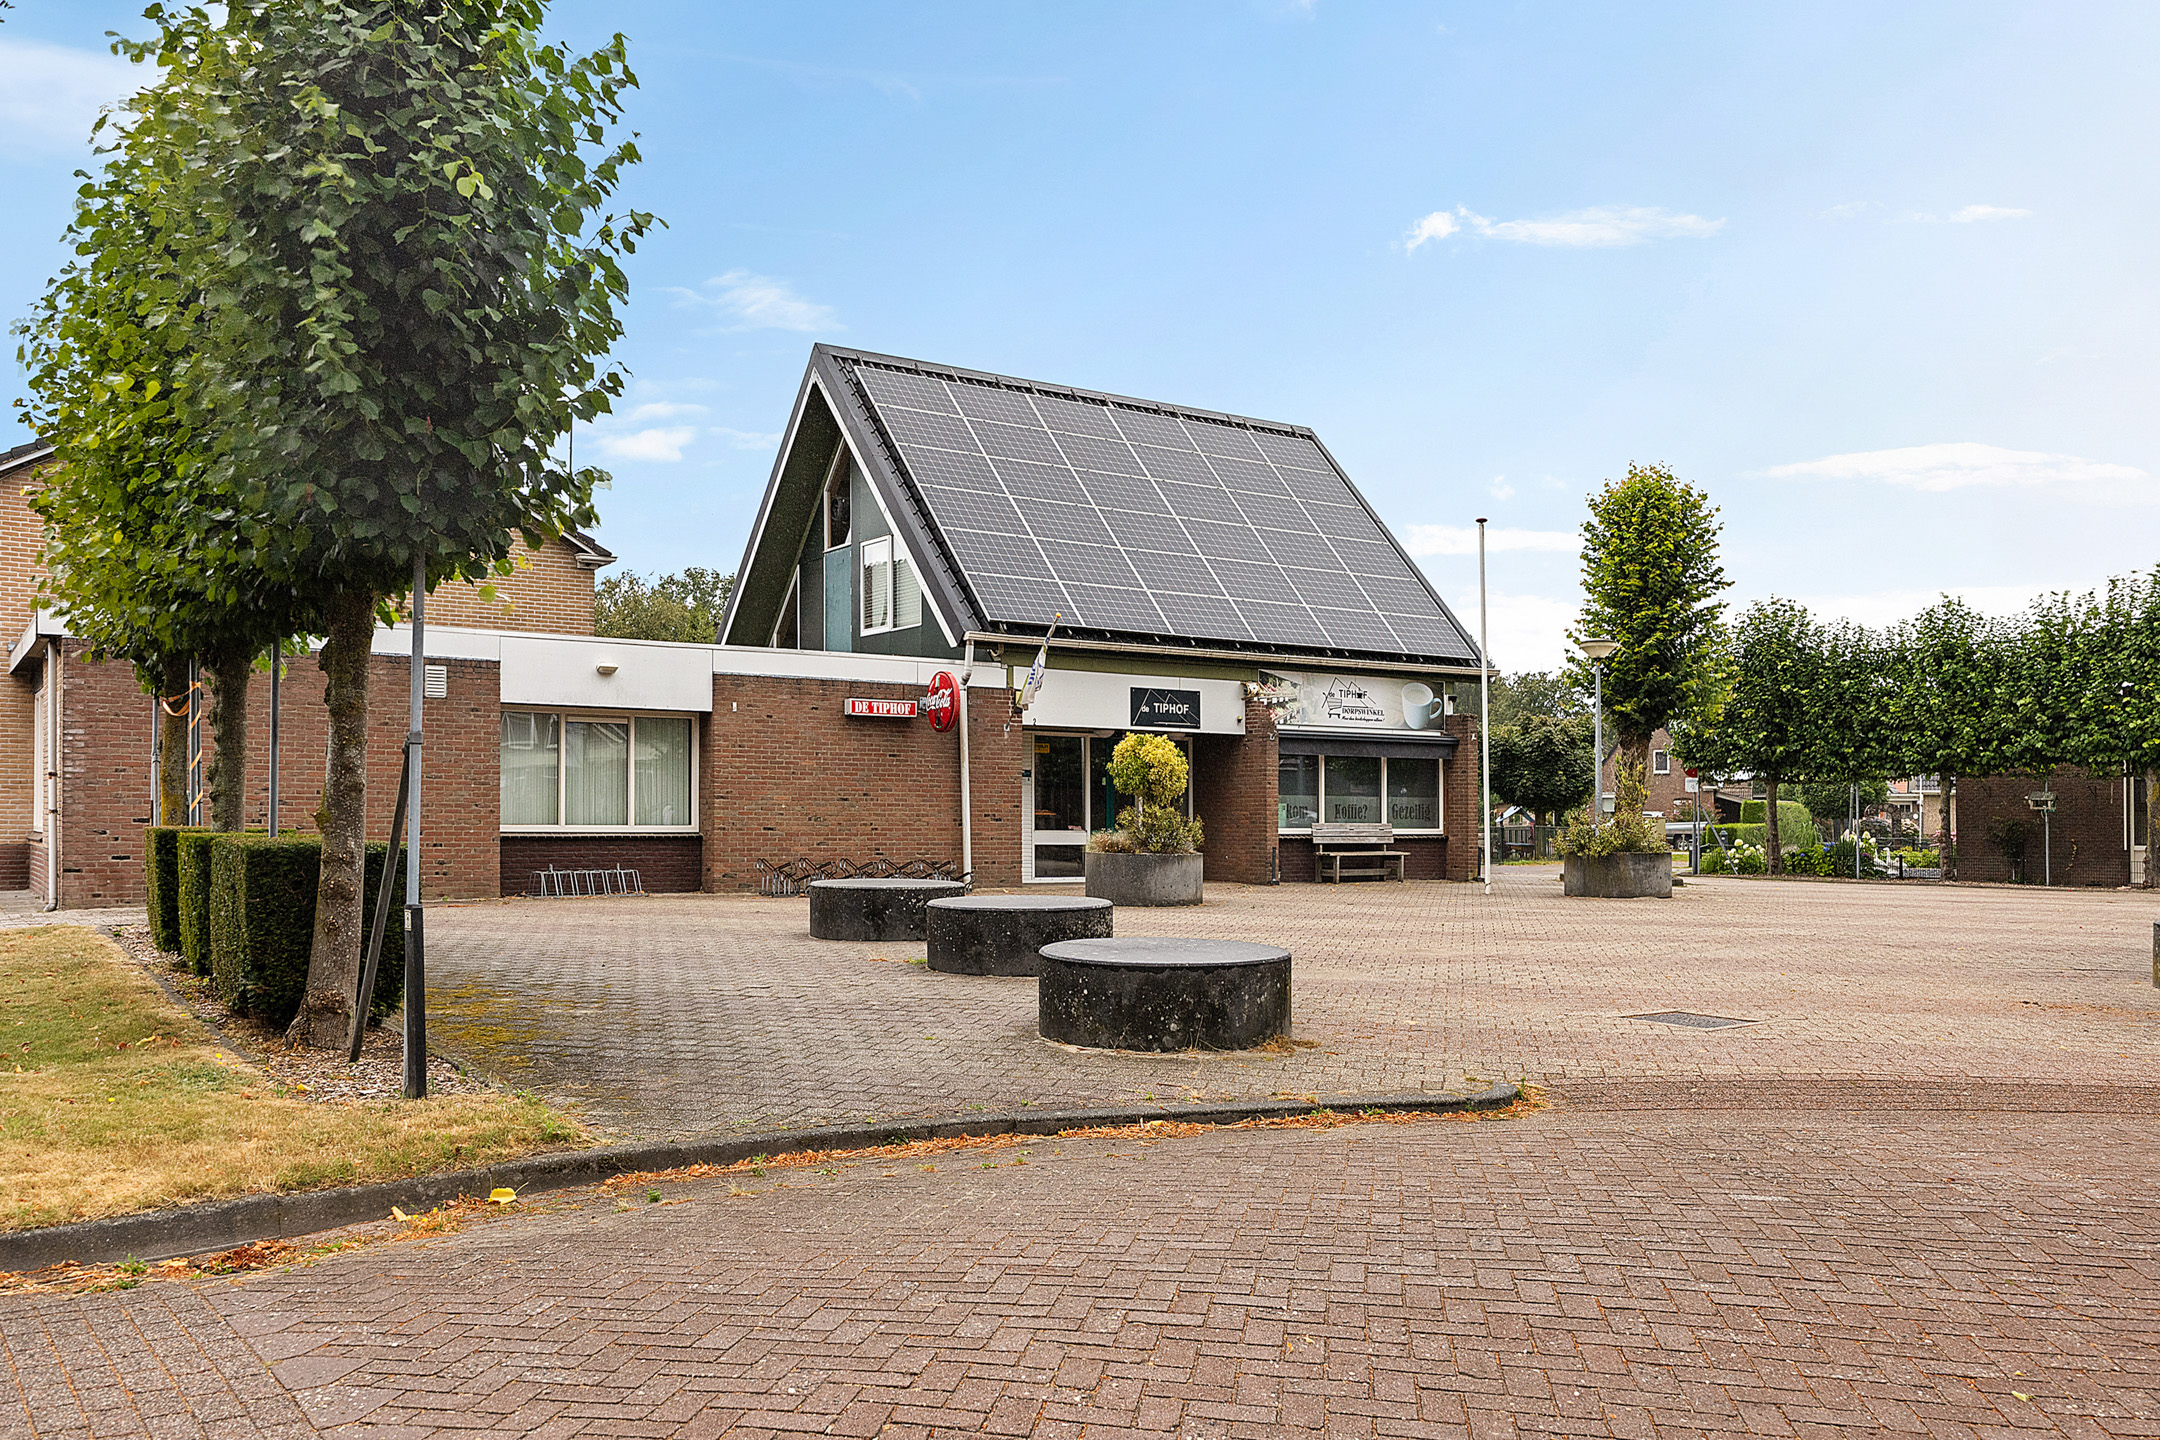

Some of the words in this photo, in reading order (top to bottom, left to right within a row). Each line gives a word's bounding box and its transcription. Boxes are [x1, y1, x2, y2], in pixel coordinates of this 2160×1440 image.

[855, 701, 869, 713] DE
[871, 701, 912, 715] TIPHOF
[1141, 705, 1150, 713] de
[1153, 702, 1190, 714] TIPHOF
[1342, 708, 1385, 716] DORPSWINKEL
[1334, 803, 1368, 819] Koffie?
[1391, 803, 1431, 821] Gezellig
